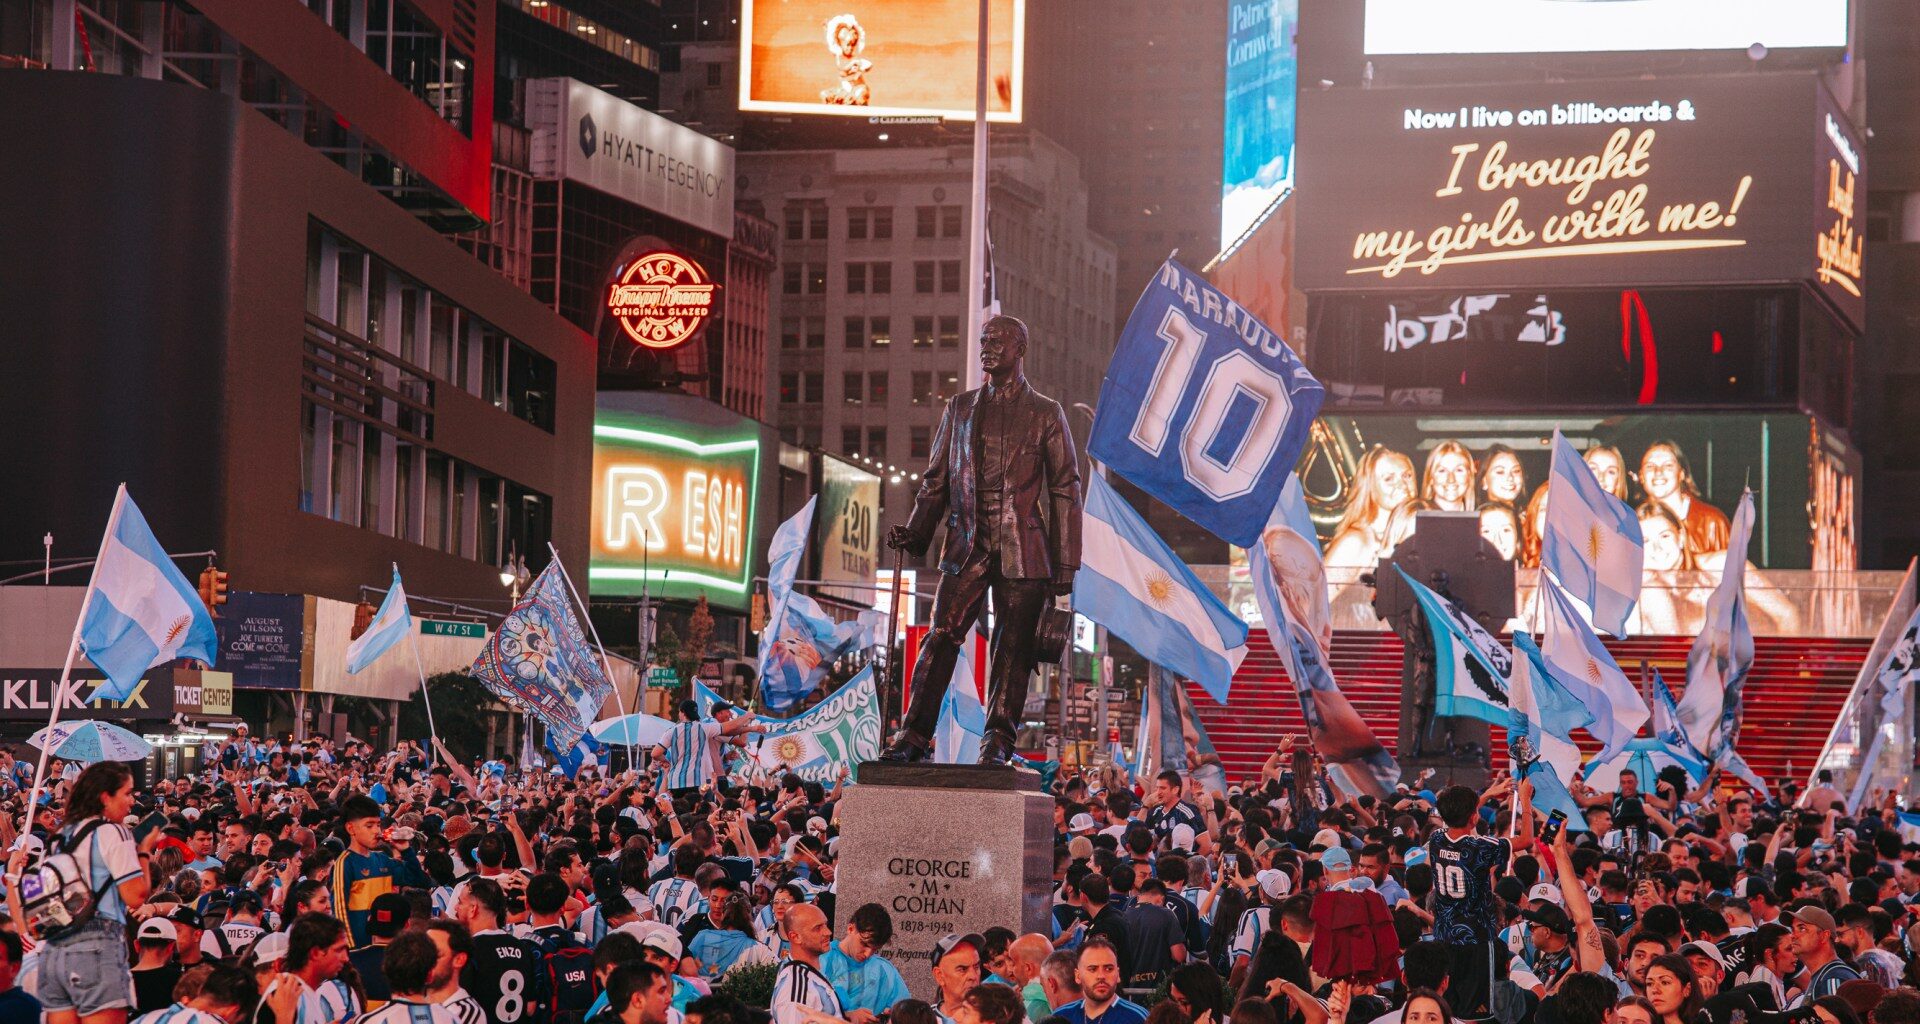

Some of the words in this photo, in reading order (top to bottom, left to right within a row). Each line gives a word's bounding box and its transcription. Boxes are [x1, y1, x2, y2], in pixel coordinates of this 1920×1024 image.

[1227, 15, 1282, 67] Cornwell
[1404, 109, 1456, 129] Now
[1460, 107, 1468, 128] I
[1472, 106, 1513, 127] live
[1517, 109, 1547, 126] on
[1551, 101, 1672, 125] billboards
[1676, 100, 1696, 120] &
[603, 131, 654, 173] HYATT
[658, 153, 724, 199] REGENCY
[1435, 143, 1480, 197] I
[1477, 127, 1656, 205] brought
[1352, 229, 1424, 279] my
[1421, 196, 1536, 275] girls
[1541, 183, 1649, 243] with
[1656, 175, 1752, 233] me!
[638, 260, 685, 281] HOT
[608, 284, 661, 308] Krispy
[660, 284, 714, 307] Kreme
[613, 308, 665, 316] ORIGINAL
[668, 308, 708, 316] GLAZED
[636, 318, 685, 341] NOW
[1128, 304, 1293, 502] 10
[842, 498, 870, 552] 120
[842, 550, 871, 577] YEARS
[240, 625, 283, 633] WILSON'S
[245, 617, 280, 625] AUGUST
[434, 624, 444, 634] W
[447, 625, 458, 635] 47
[461, 626, 471, 636] St
[231, 642, 255, 652] COME
[265, 644, 290, 653] GONE
[239, 634, 252, 642] JOE
[254, 635, 283, 643] TURNER'S
[661, 669, 669, 677] 47
[3, 679, 150, 709] KLIKTX
[175, 685, 202, 706] TICKET
[203, 688, 231, 707] CENTER
[763, 681, 869, 732] PARADOS
[1439, 849, 1460, 861] MESSI
[888, 858, 970, 879] GEORGE
[920, 879, 938, 896] M
[1435, 863, 1466, 899] 10
[893, 896, 964, 915] COHAN
[901, 921, 954, 935] 1878-1942
[495, 947, 522, 959] ENZO
[565, 970, 586, 982] USA
[495, 969, 525, 1023] 8
